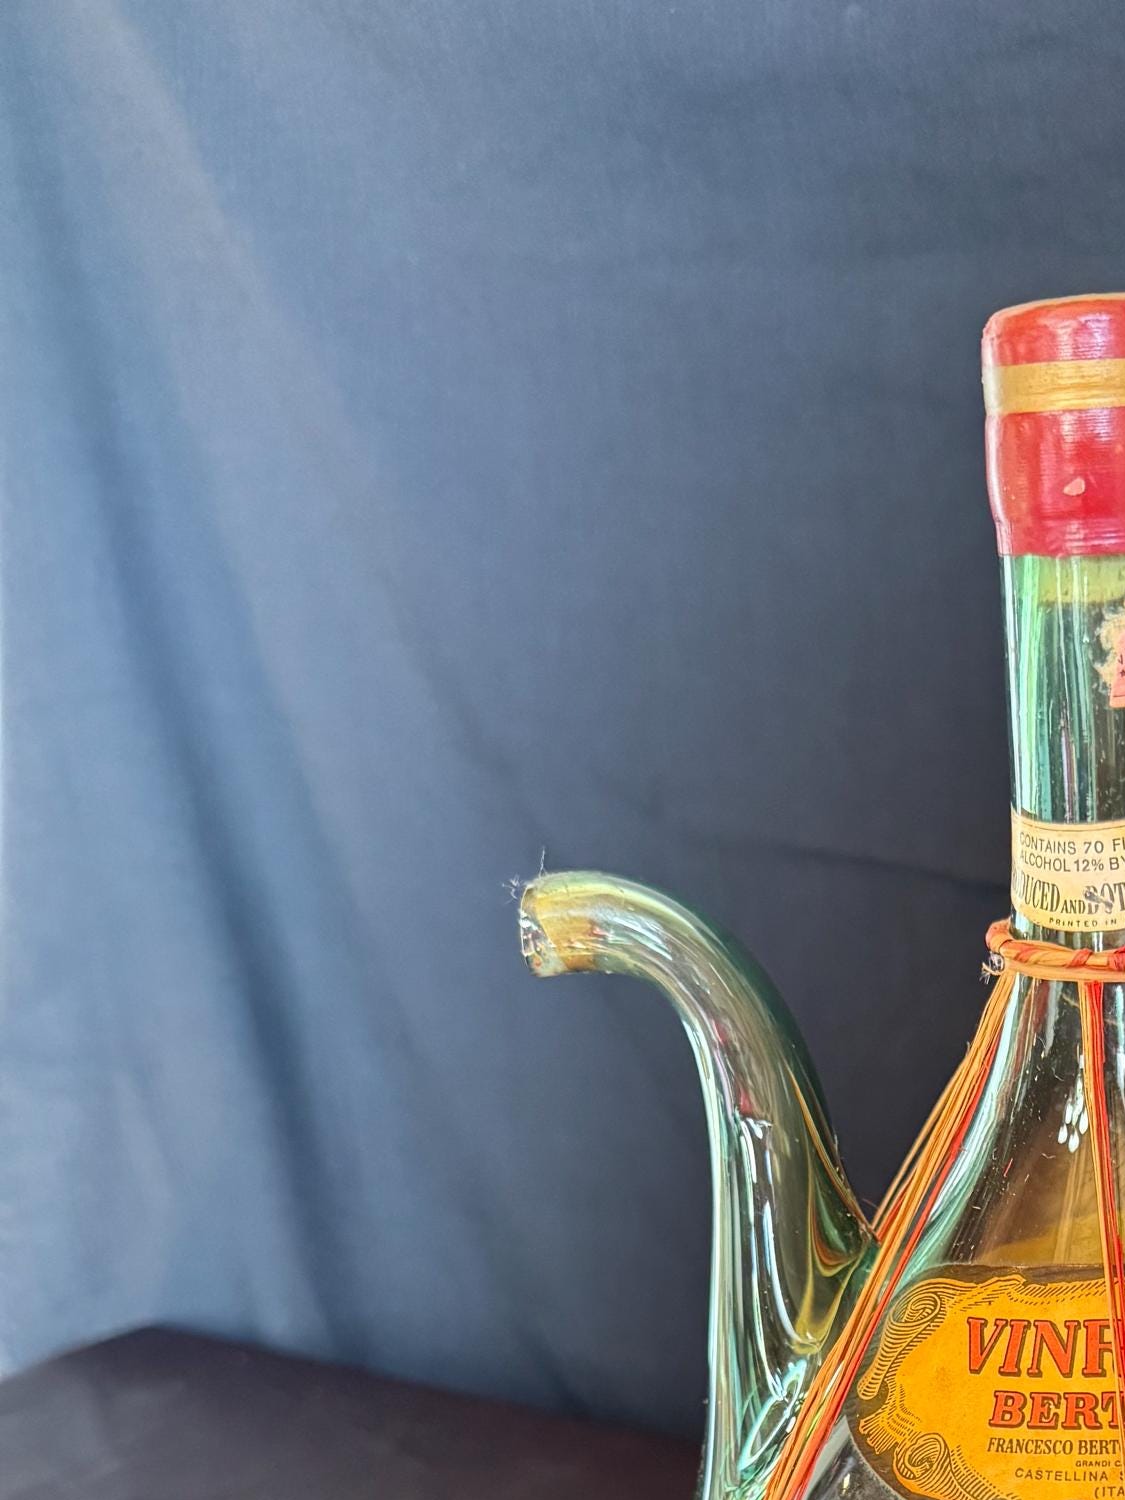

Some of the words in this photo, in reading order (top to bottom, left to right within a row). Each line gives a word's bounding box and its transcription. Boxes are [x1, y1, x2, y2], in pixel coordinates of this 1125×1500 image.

[1019, 832, 1076, 855] CONTAINS
[1083, 841, 1104, 854] 70
[1020, 849, 1071, 872] ALCOHOL
[1074, 858, 1104, 872] 12%
[1060, 900, 1086, 915] AND
[1049, 917, 1098, 928] PRINTED
[1105, 918, 1117, 926] IN
[987, 1437, 1074, 1455] FRANCESCO
[1075, 1459, 1112, 1468] GRANDI
[1015, 1467, 1109, 1482] CASTELLINA
